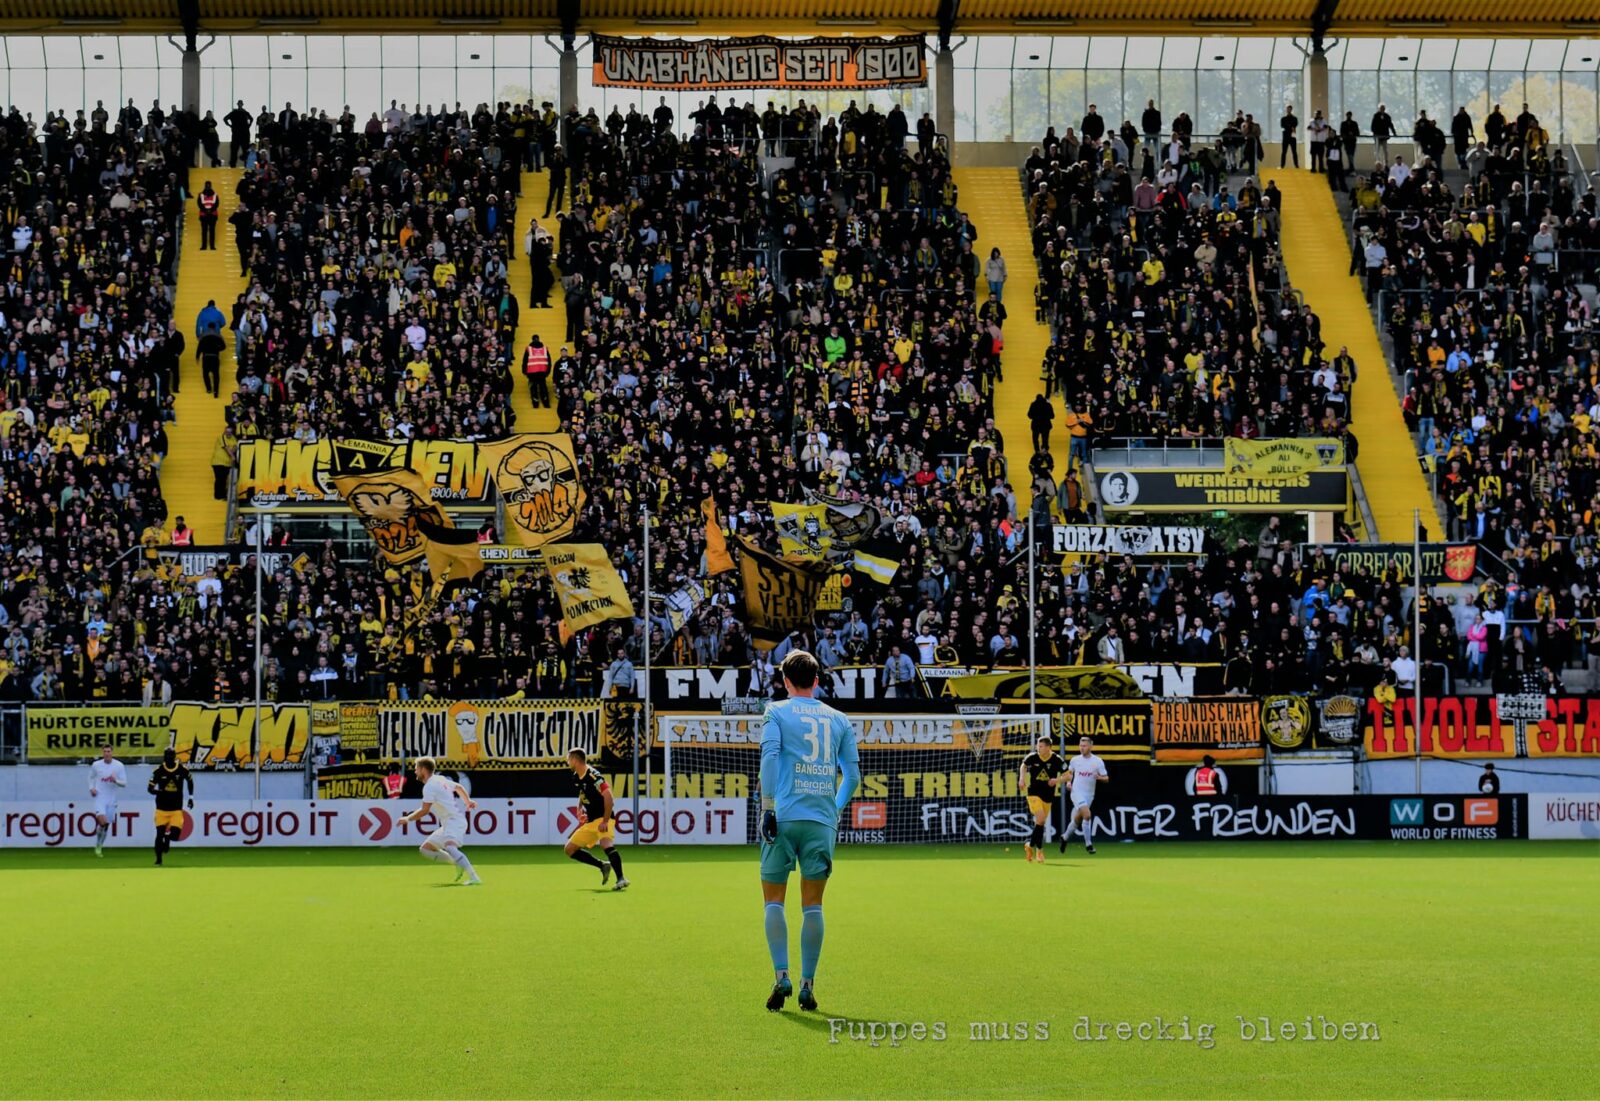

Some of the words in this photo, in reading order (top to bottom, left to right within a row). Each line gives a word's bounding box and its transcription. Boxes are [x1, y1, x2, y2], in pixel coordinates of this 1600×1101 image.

[602, 43, 780, 83] UNABHÄNGIG
[785, 46, 849, 81] SEIT
[855, 45, 921, 80] 1900
[431, 487, 453, 498] 1900
[1204, 487, 1281, 504] TRIBÜNE
[520, 483, 570, 530] 2014
[1052, 525, 1118, 552] FORZA
[1150, 527, 1206, 553] ATSV
[30, 714, 169, 730] HÜRTGENWALD
[1076, 714, 1147, 736] WACHT
[1158, 703, 1256, 722] FREUNDSCHAFT
[1367, 697, 1505, 752] TIVOLI
[46, 732, 155, 748] RUREIFEL
[379, 710, 448, 758] YELLOW
[484, 710, 600, 758] CONNECTION
[800, 716, 832, 763] 31
[1156, 721, 1257, 742] ZUSAMMENHALT
[795, 763, 836, 776] BANGSOW
[1191, 803, 1356, 837] FREUNDEN
[1546, 797, 1600, 822] KÜCHE
[203, 803, 299, 846] regio
[1390, 827, 1430, 839] WORLD
[1433, 827, 1446, 839] OF
[1450, 827, 1497, 839] FITNESS
